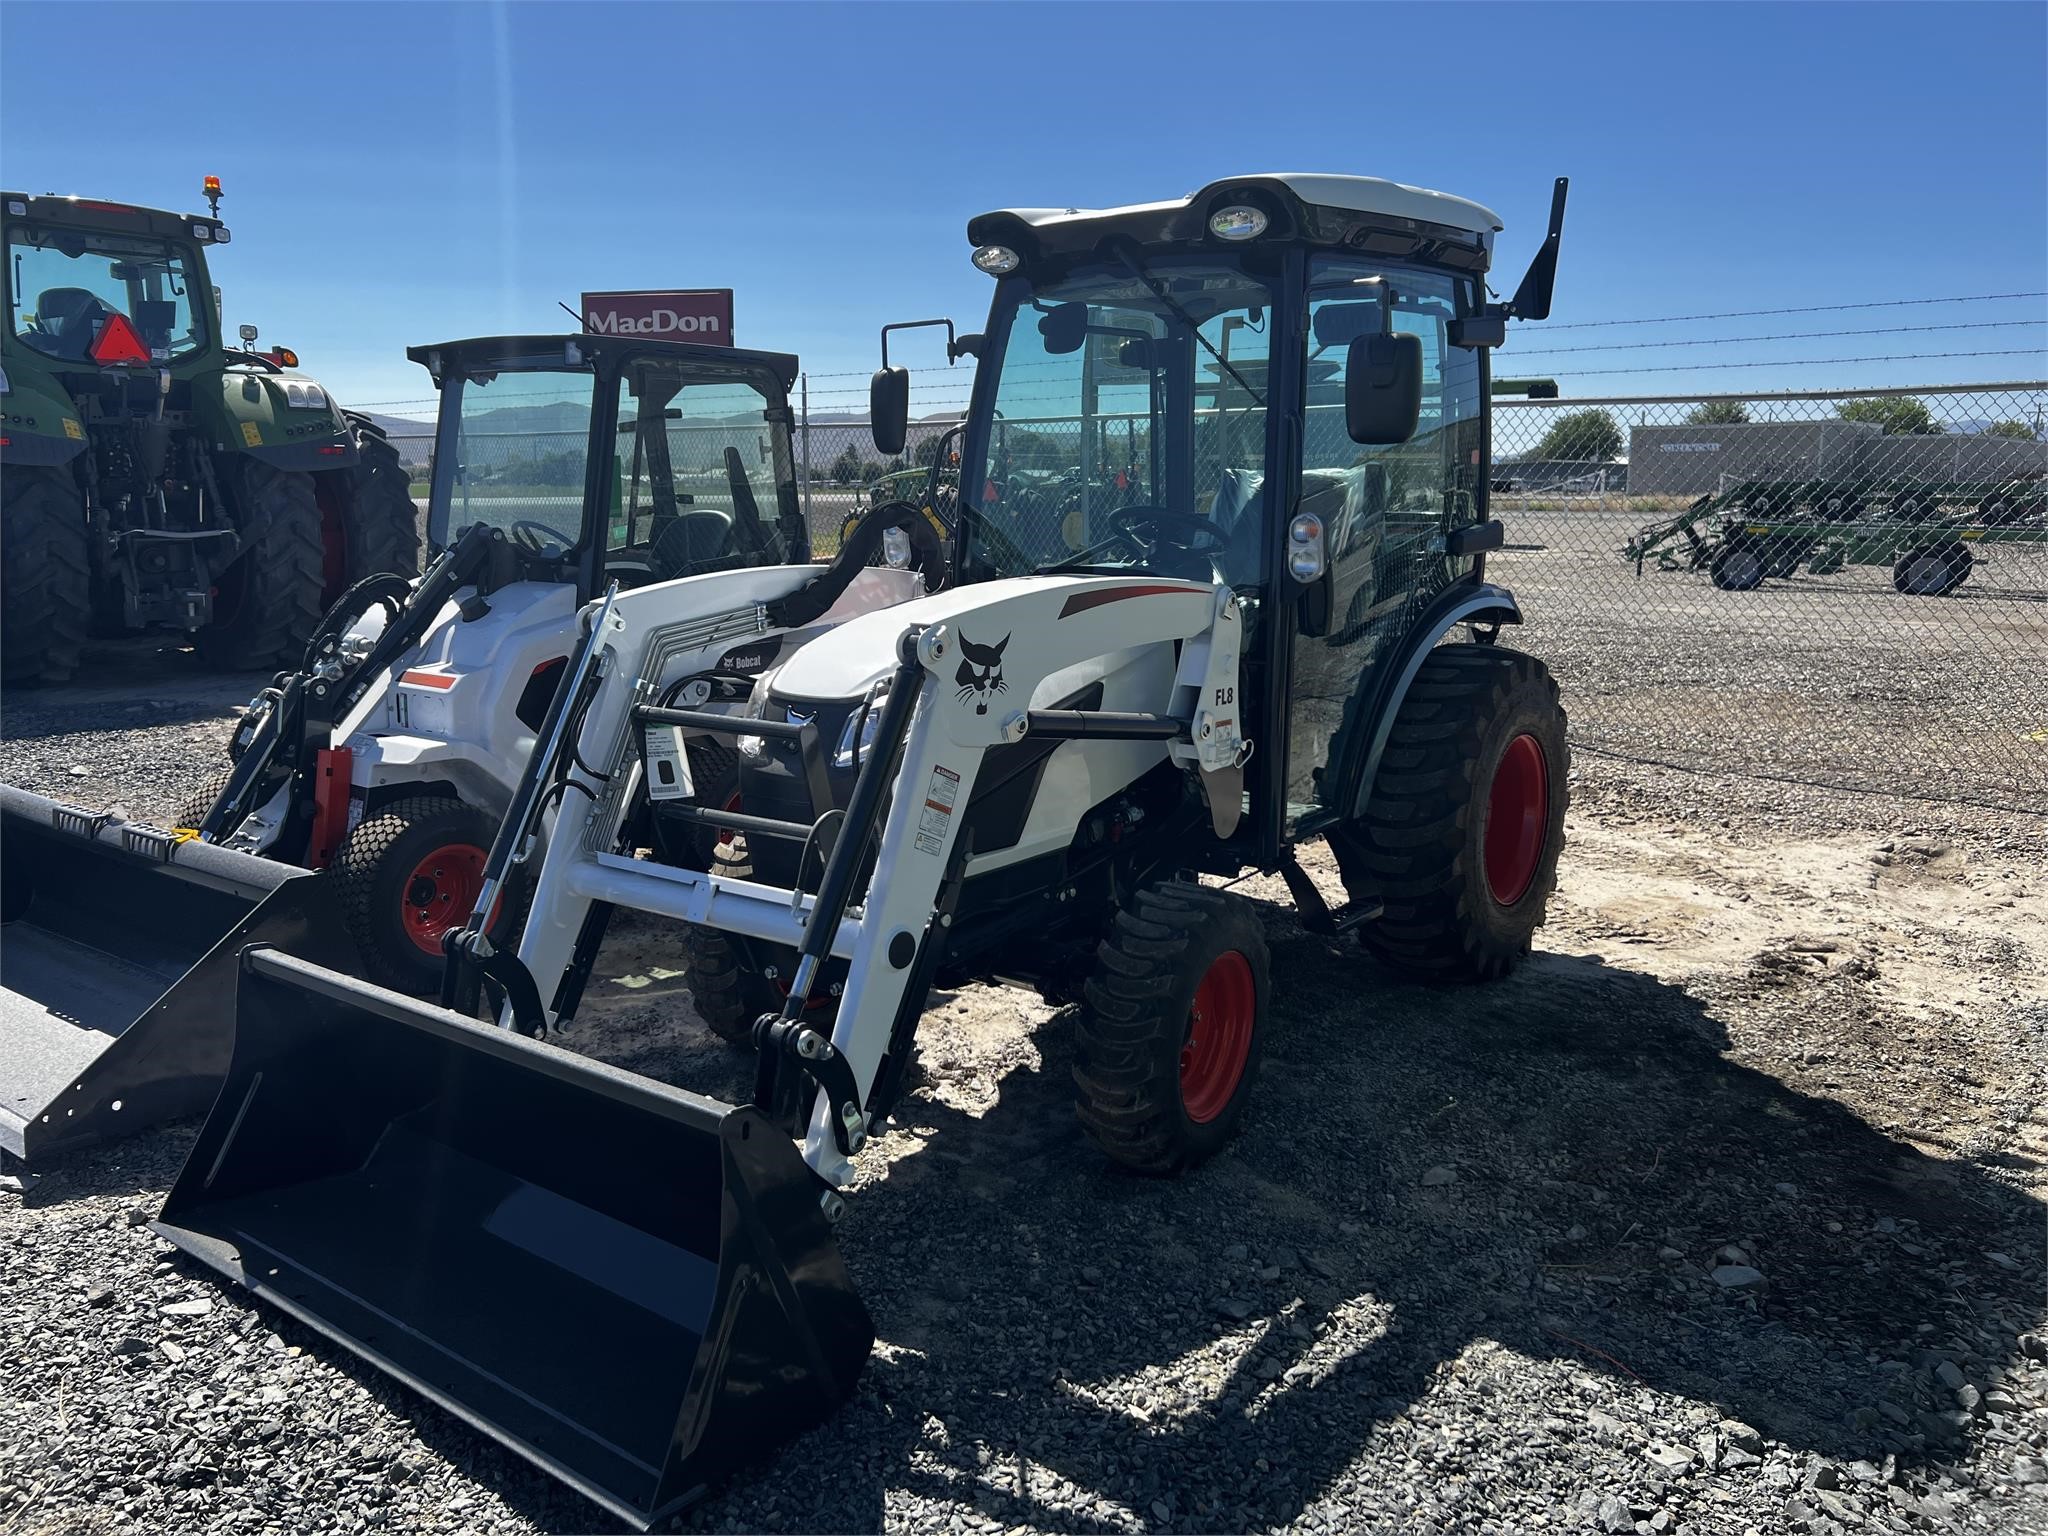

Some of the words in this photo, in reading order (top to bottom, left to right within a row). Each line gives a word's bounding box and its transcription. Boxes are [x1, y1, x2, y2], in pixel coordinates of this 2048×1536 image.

[588, 309, 719, 334] MacDon
[736, 655, 761, 669] Bobcat
[1215, 687, 1233, 706] FL8
